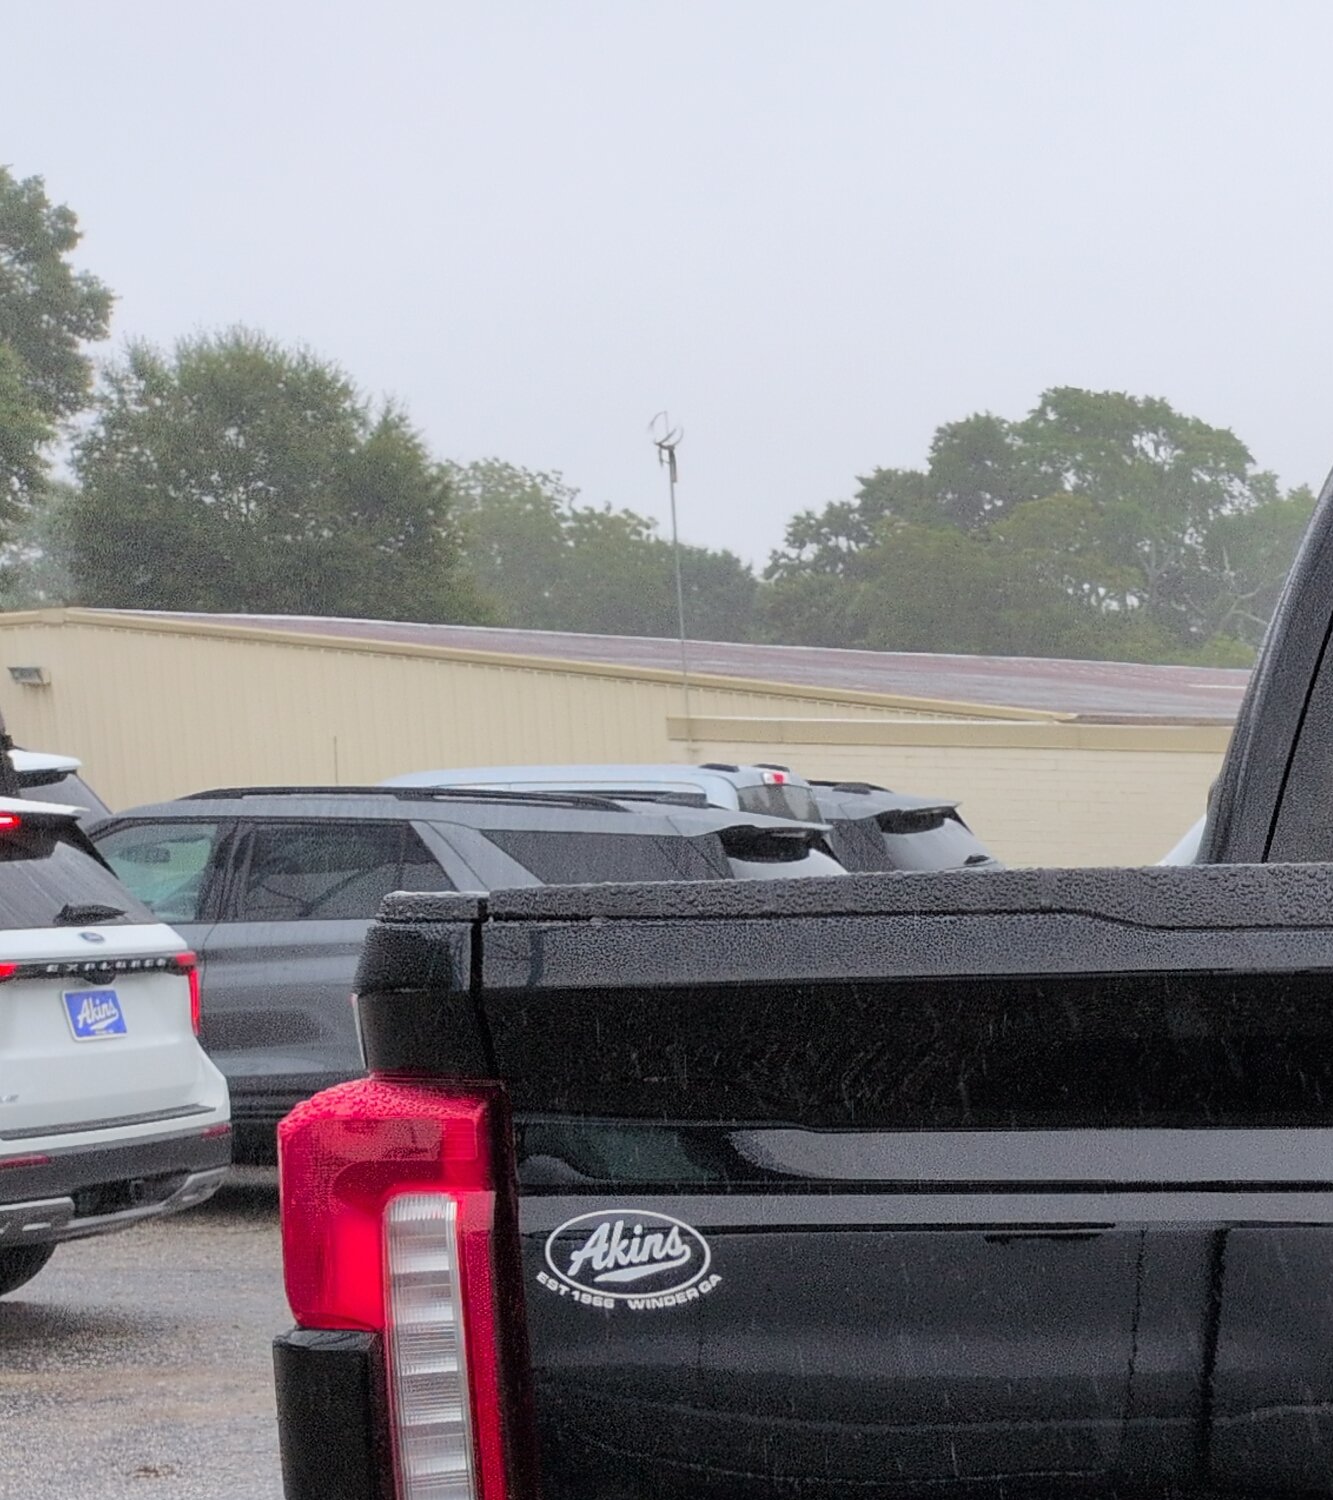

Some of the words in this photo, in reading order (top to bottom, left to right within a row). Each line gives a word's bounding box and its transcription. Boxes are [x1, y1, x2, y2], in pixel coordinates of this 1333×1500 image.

[77, 997, 119, 1028] Akins
[567, 1220, 691, 1280] Akins
[536, 1271, 570, 1296] EST
[627, 1289, 700, 1310] WINDER
[698, 1273, 722, 1293] GA
